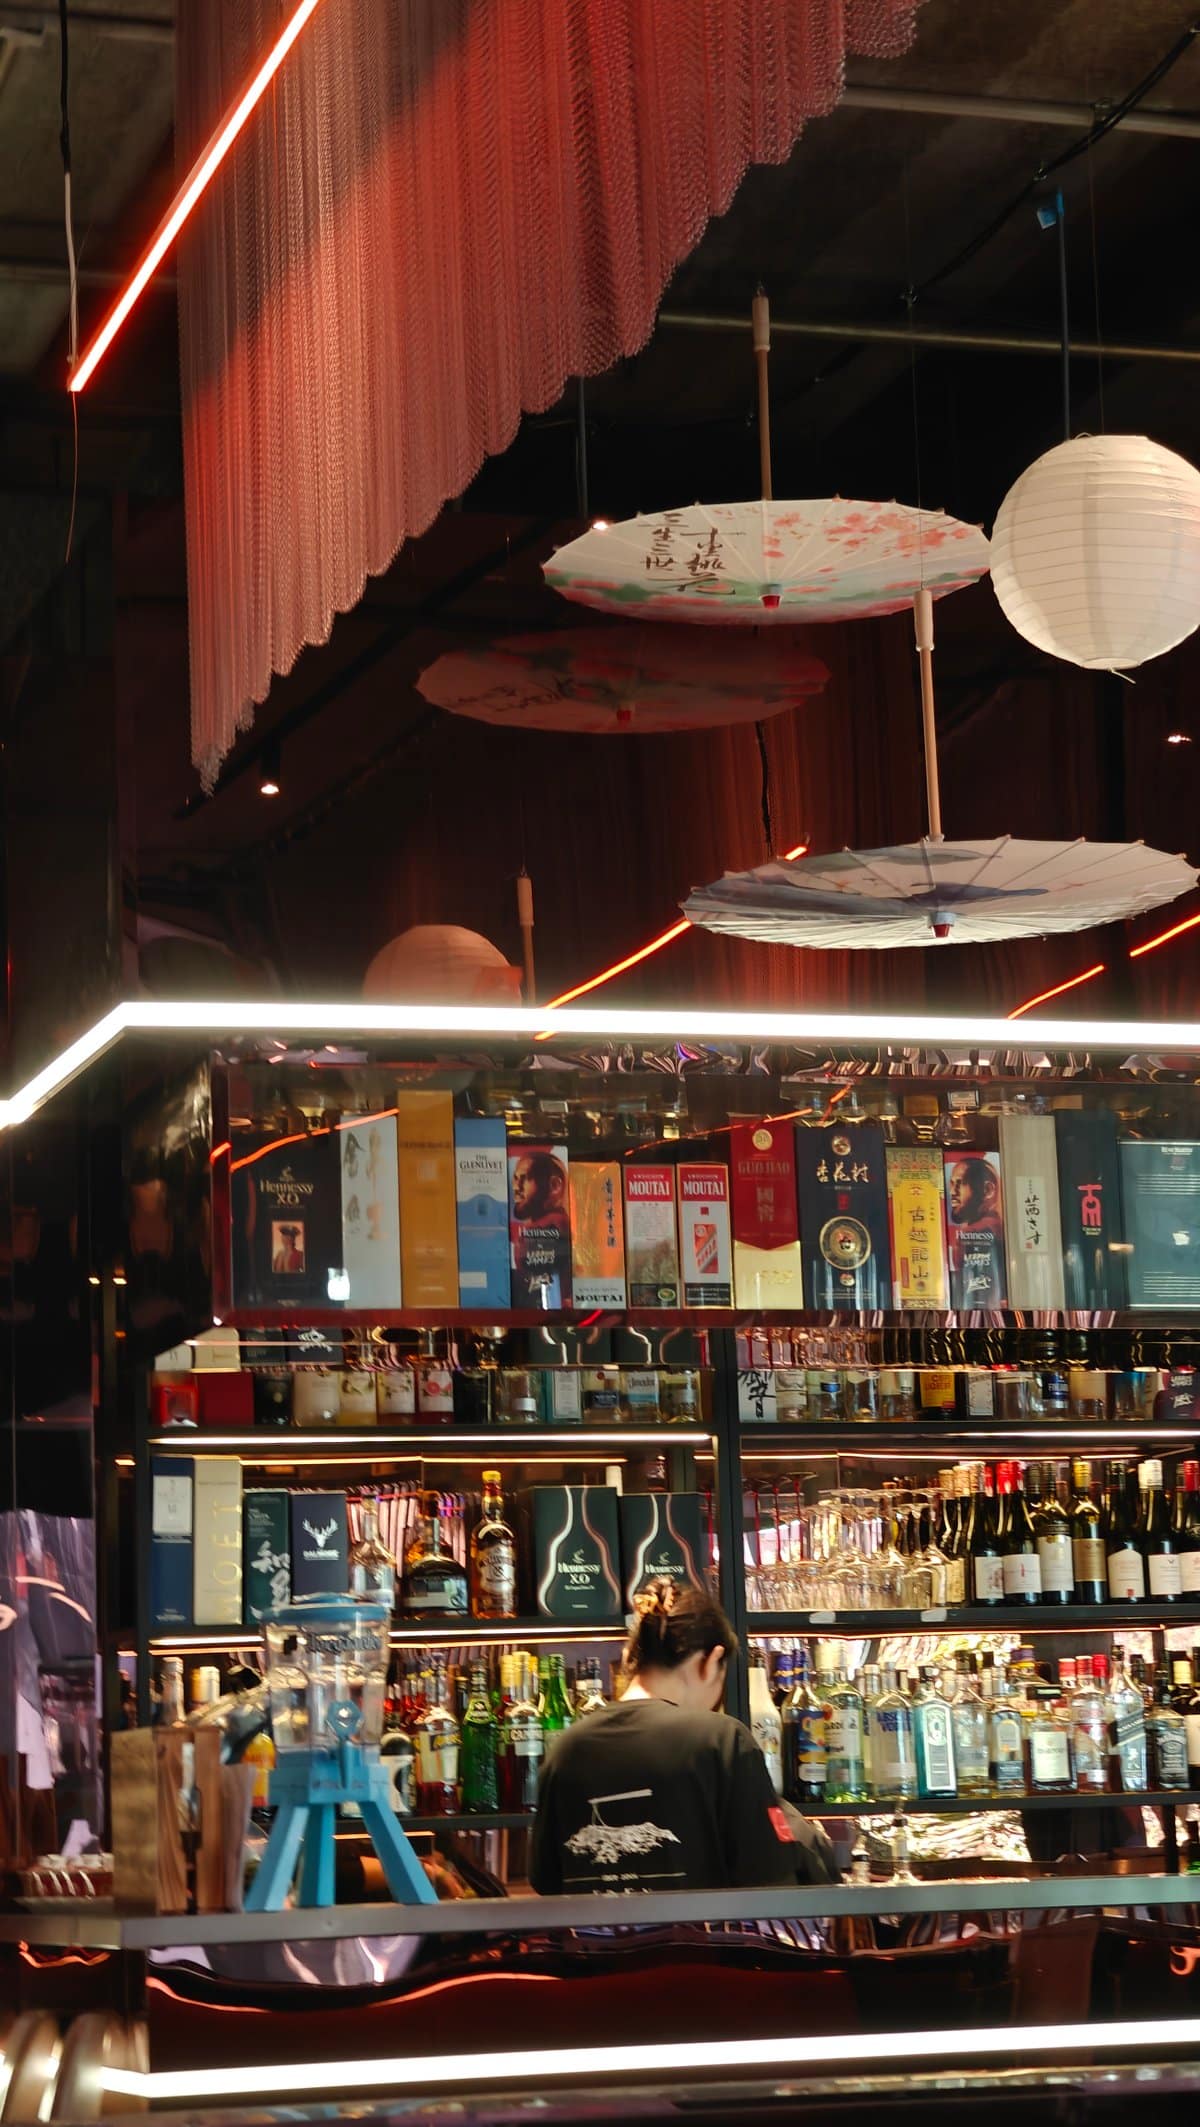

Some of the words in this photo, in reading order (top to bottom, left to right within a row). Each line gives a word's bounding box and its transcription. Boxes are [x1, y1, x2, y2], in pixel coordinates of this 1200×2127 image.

[815, 1159, 870, 1183] 杏花村
[260, 1179, 314, 1194] Hennessy
[628, 1180, 670, 1196] MOUTAI
[682, 1181, 724, 1196] MOUTAI
[518, 1226, 560, 1239] Hennessy
[955, 1230, 994, 1242] Hennessy
[575, 1294, 624, 1303] MOUTAI
[557, 1562, 600, 1575] Hennessy
[645, 1564, 685, 1575] Hennessy
[570, 1573, 591, 1585] XO
